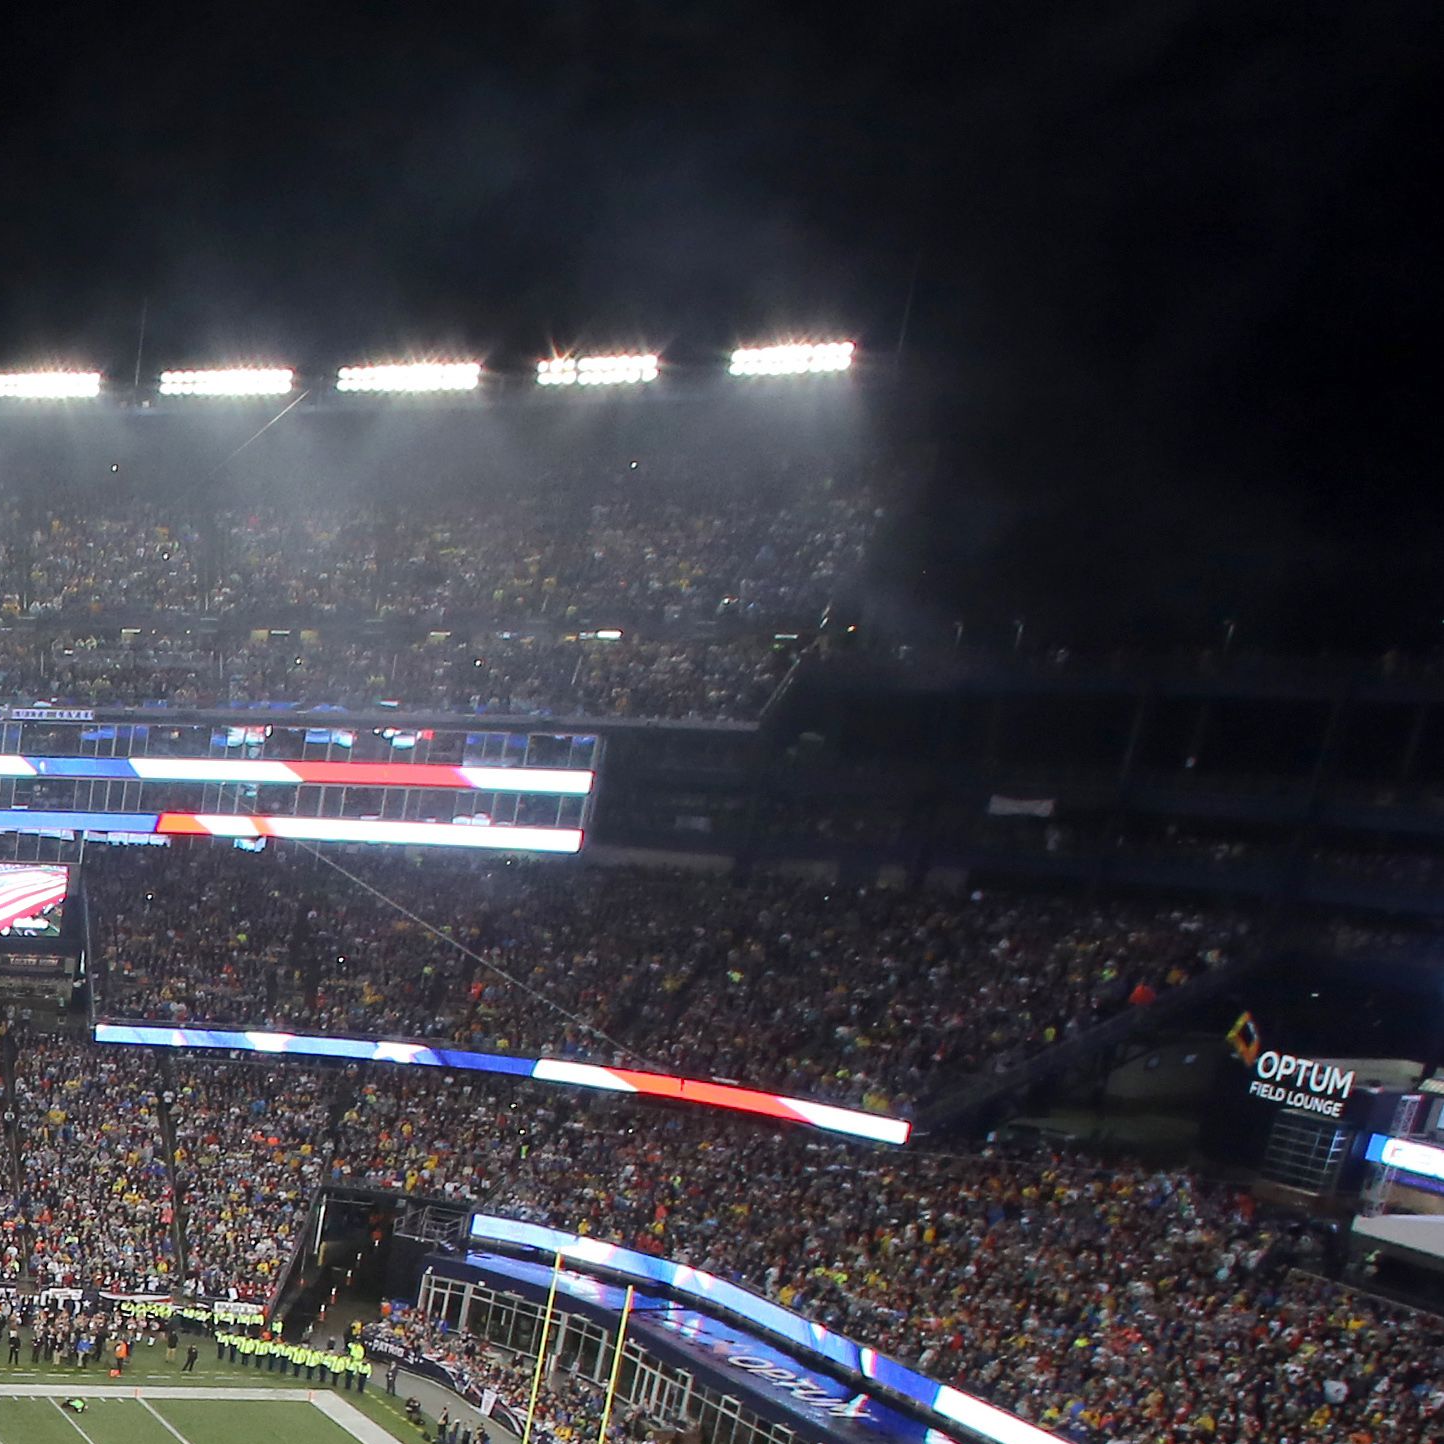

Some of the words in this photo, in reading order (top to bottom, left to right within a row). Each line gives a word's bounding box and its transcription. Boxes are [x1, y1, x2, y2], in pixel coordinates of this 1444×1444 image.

[1256, 1051, 1355, 1099] OPTUM
[1249, 1081, 1286, 1102] FIELD
[1286, 1090, 1344, 1118] LOUNGE
